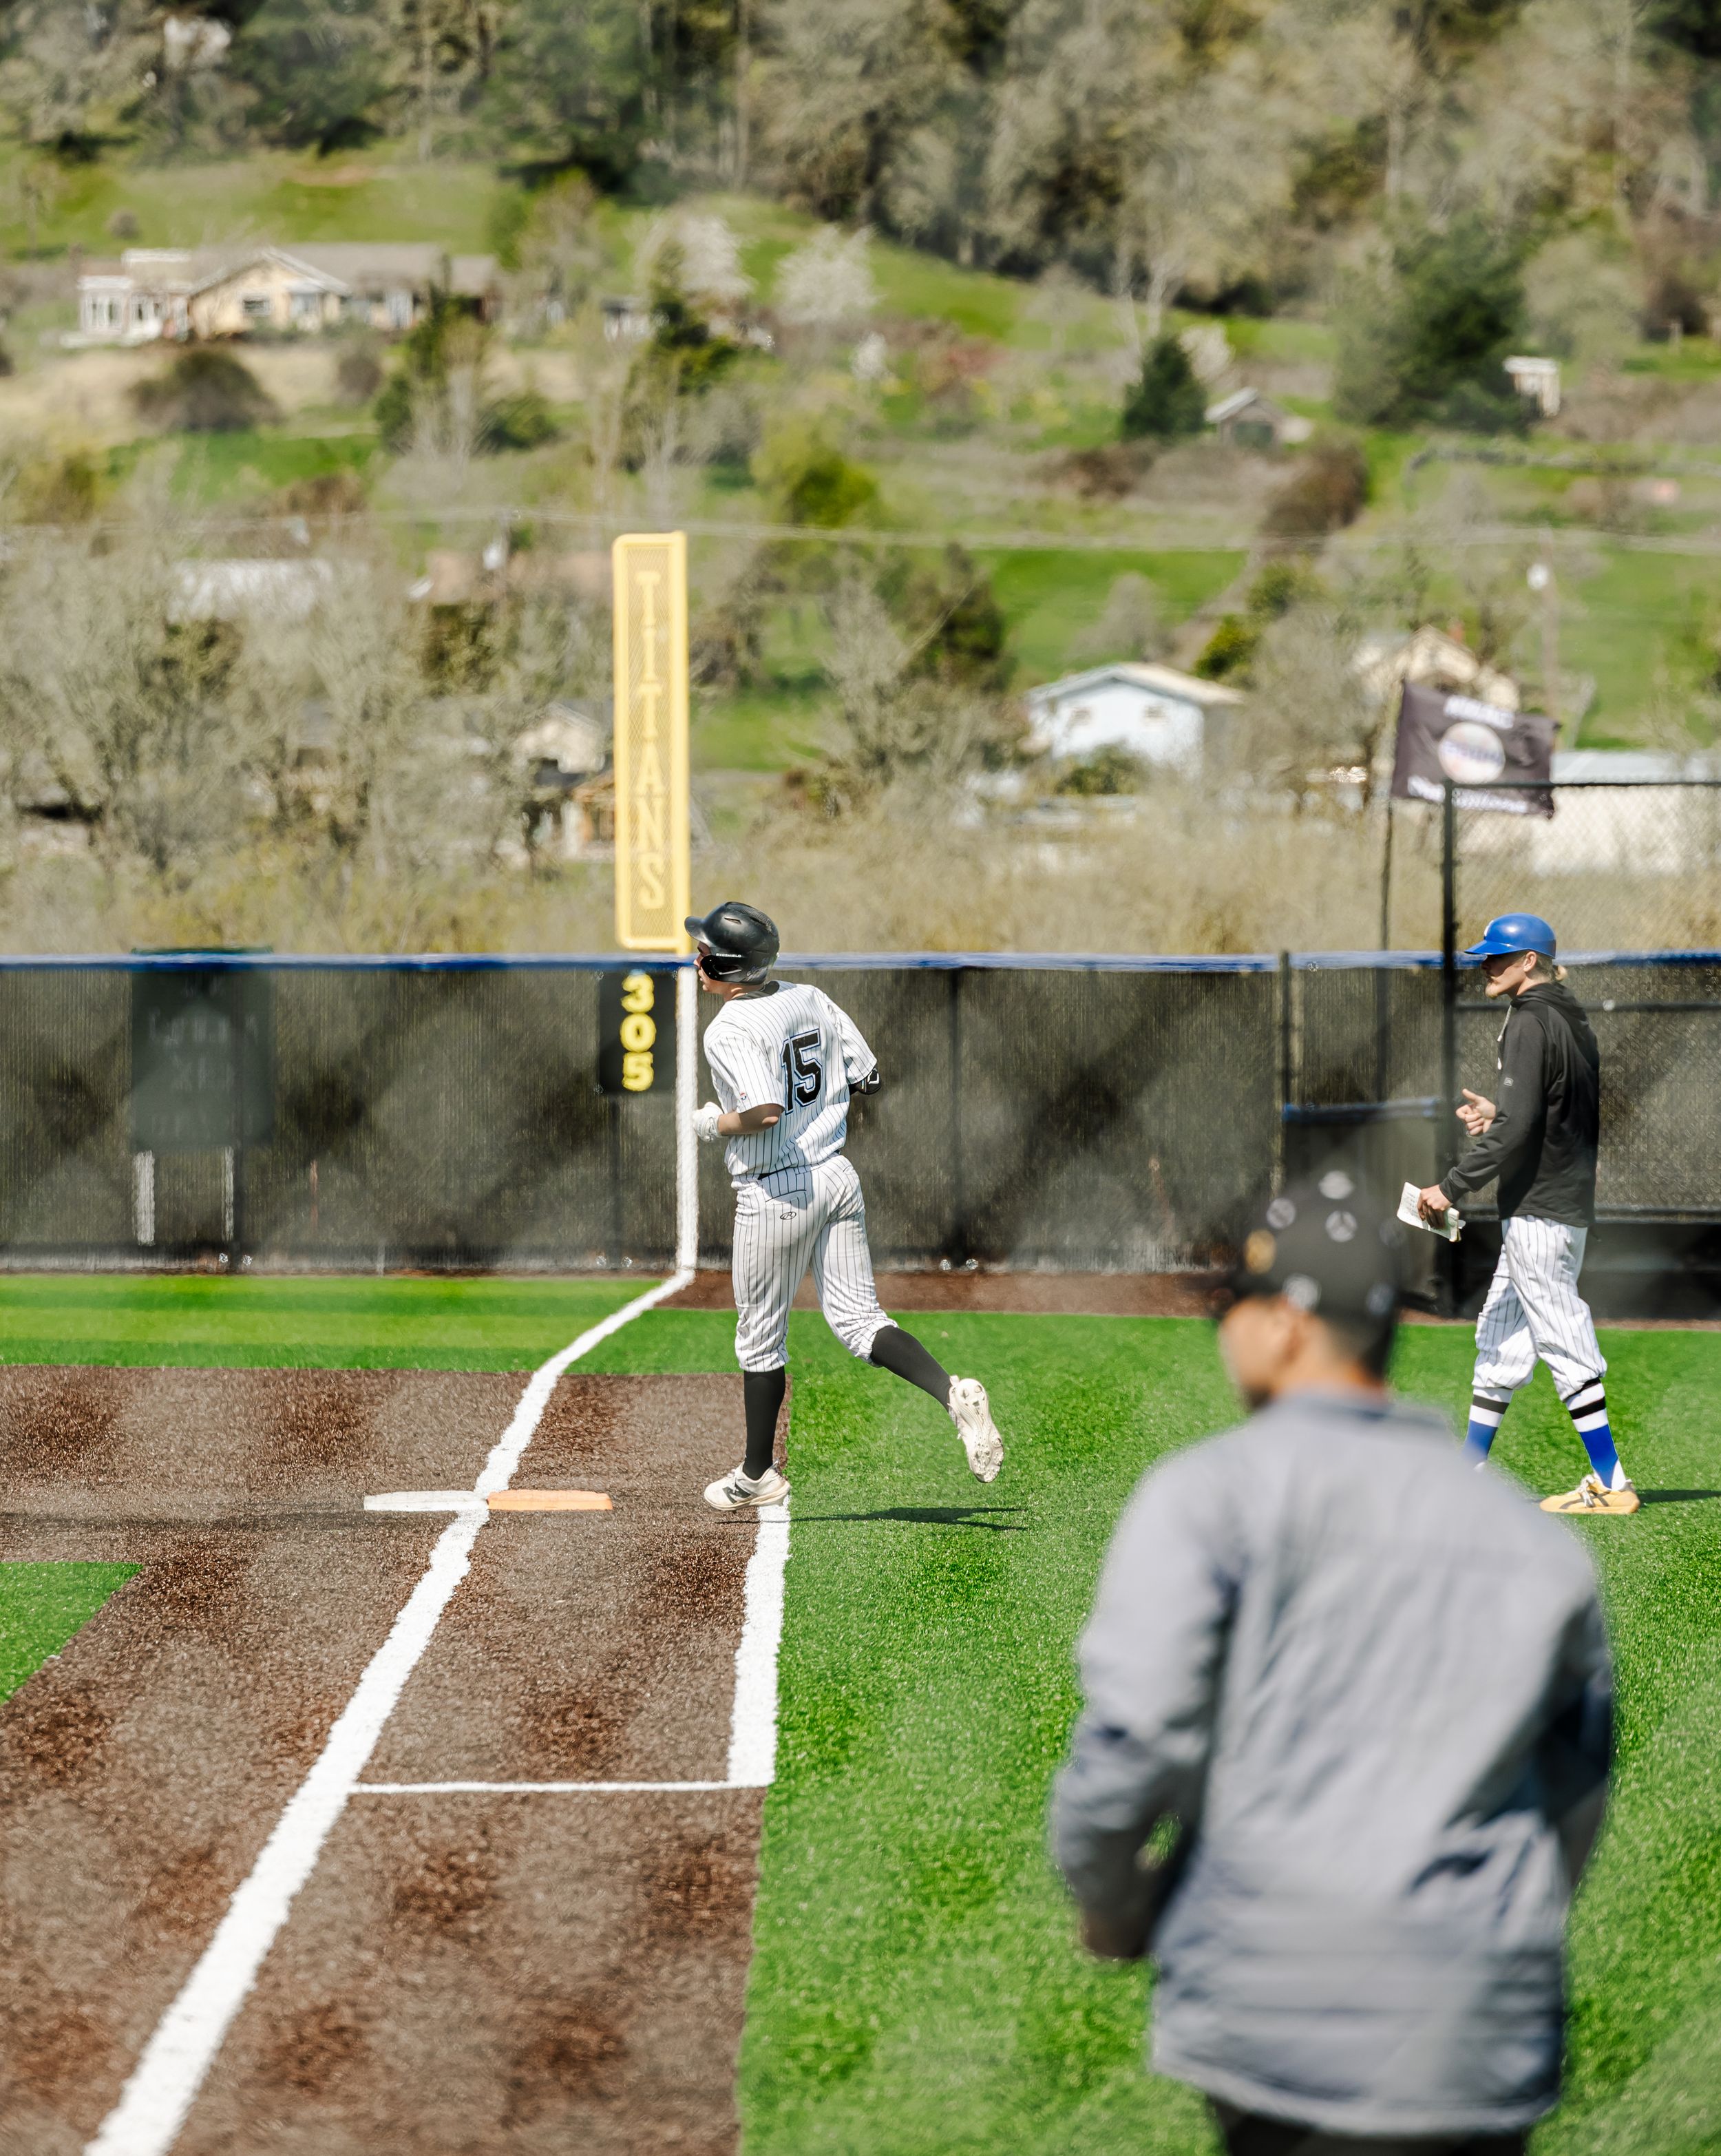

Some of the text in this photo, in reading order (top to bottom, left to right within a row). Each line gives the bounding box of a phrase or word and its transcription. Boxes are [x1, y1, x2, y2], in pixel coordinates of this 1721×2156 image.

[635, 571, 665, 910] TITANS
[621, 971, 656, 1091] 305
[780, 1029, 823, 1116] 15
